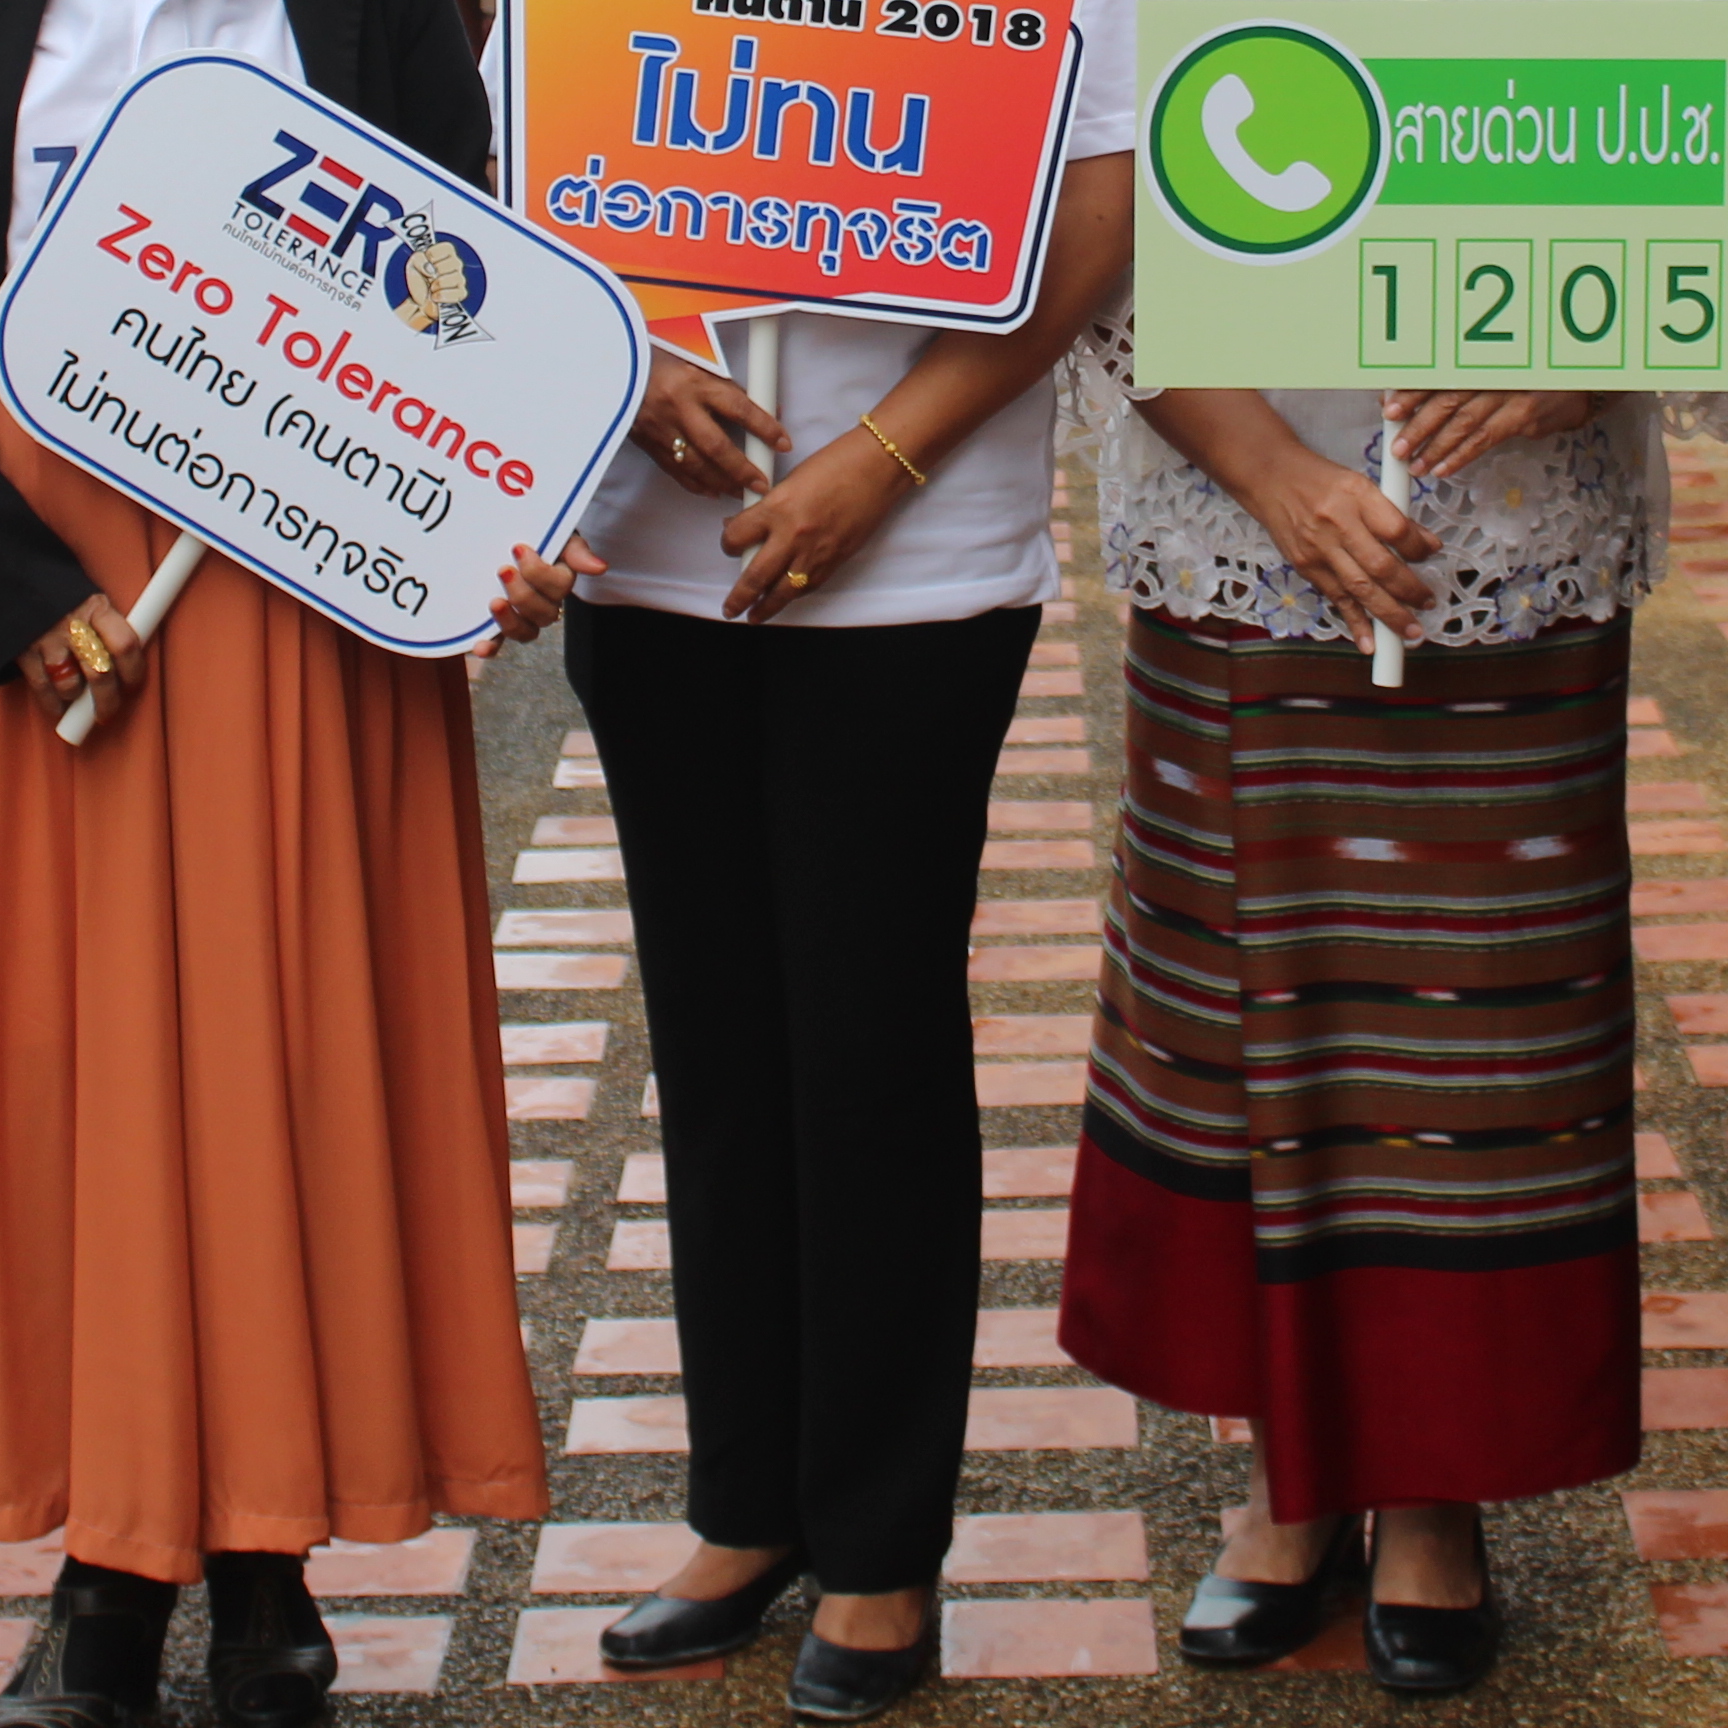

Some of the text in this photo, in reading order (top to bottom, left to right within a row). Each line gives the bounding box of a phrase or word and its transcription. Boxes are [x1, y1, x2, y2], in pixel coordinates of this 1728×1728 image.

[881, 0, 1043, 47] 2018
[630, 34, 928, 174] ไม่ทน
[1395, 78, 1721, 165] สายด่วน ป.ป.ช.
[230, 201, 375, 299] TOLERANCE
[549, 159, 990, 273] ต่อการทุจริต
[96, 203, 535, 498] Zero Tolerance
[1372, 264, 1715, 344] 1205
[111, 306, 453, 534] คนไทย (คนตานี)
[47, 350, 429, 618] ไม่ทนต่อการทุจริต
